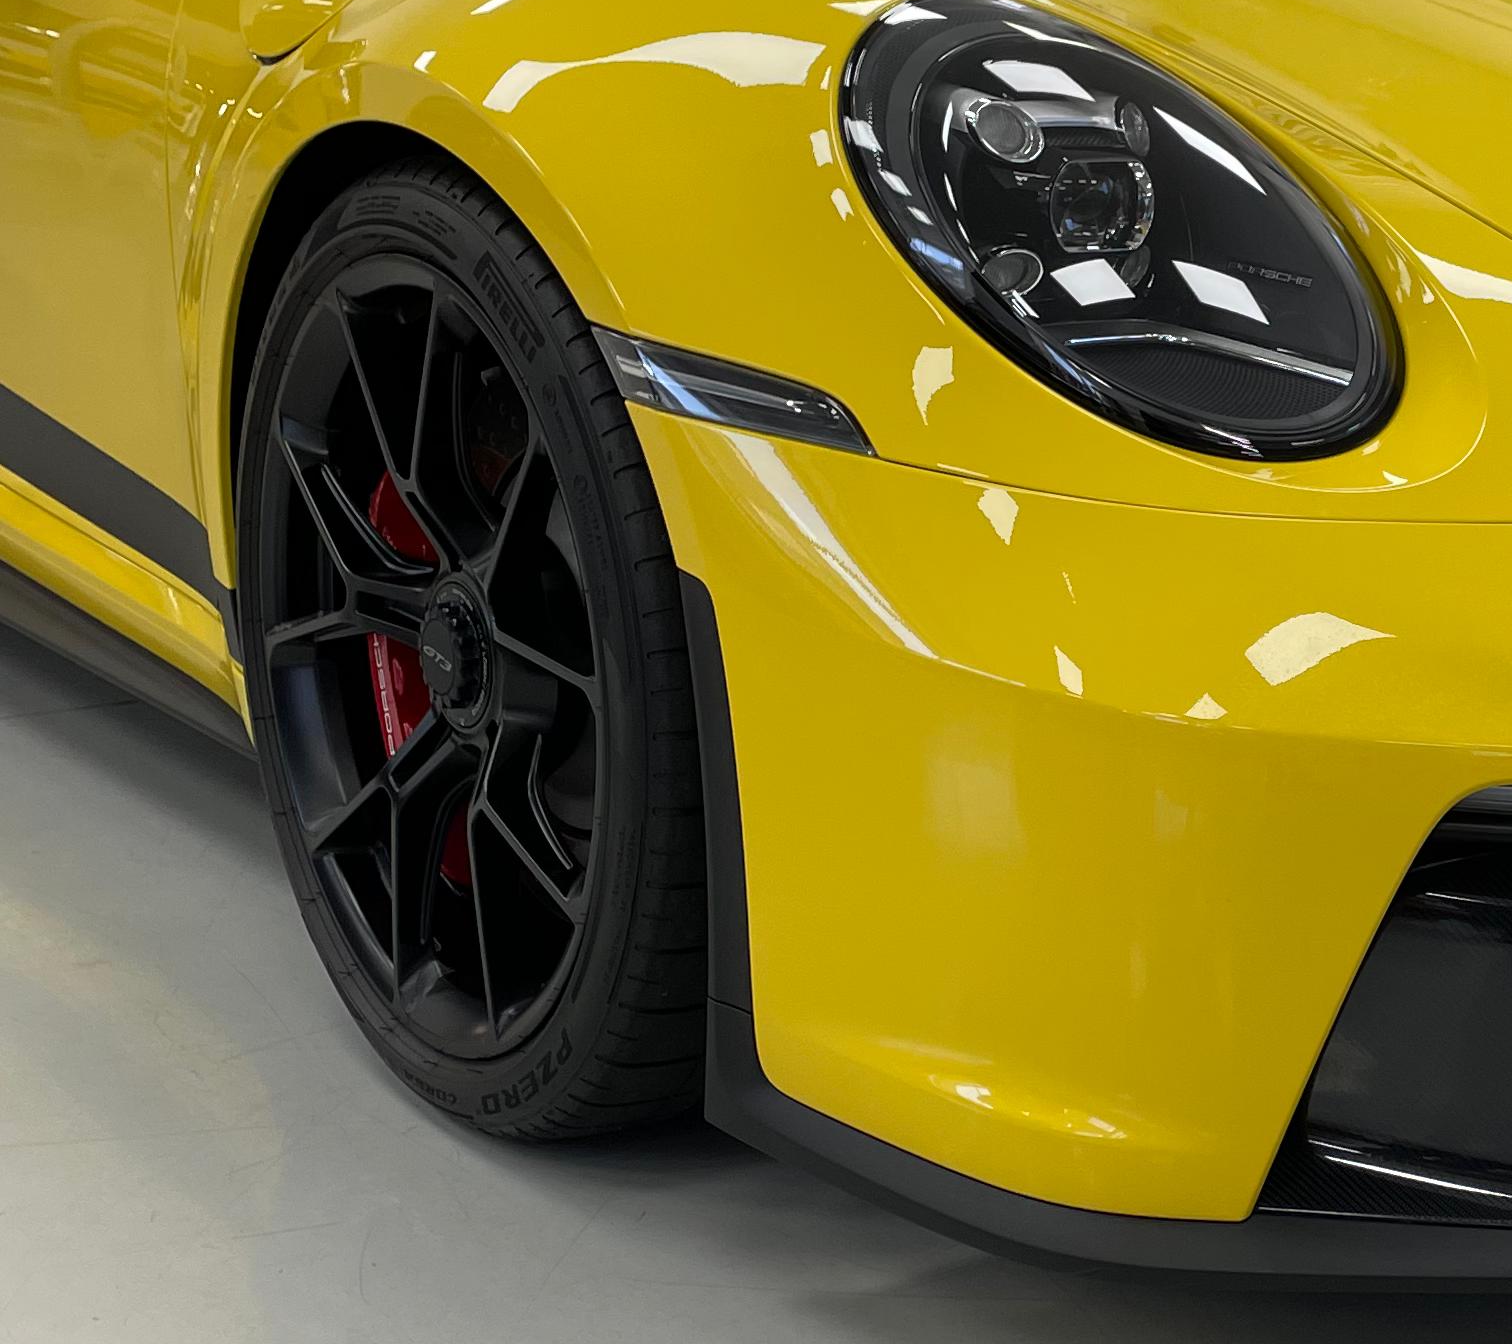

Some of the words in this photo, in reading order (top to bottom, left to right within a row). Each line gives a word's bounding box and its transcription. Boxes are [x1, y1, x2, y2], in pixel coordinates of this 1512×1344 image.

[472, 250, 545, 363] PIRELLI
[1227, 261, 1313, 288] PORSCHE
[373, 632, 396, 757] PORSCH
[423, 644, 452, 674] GT3
